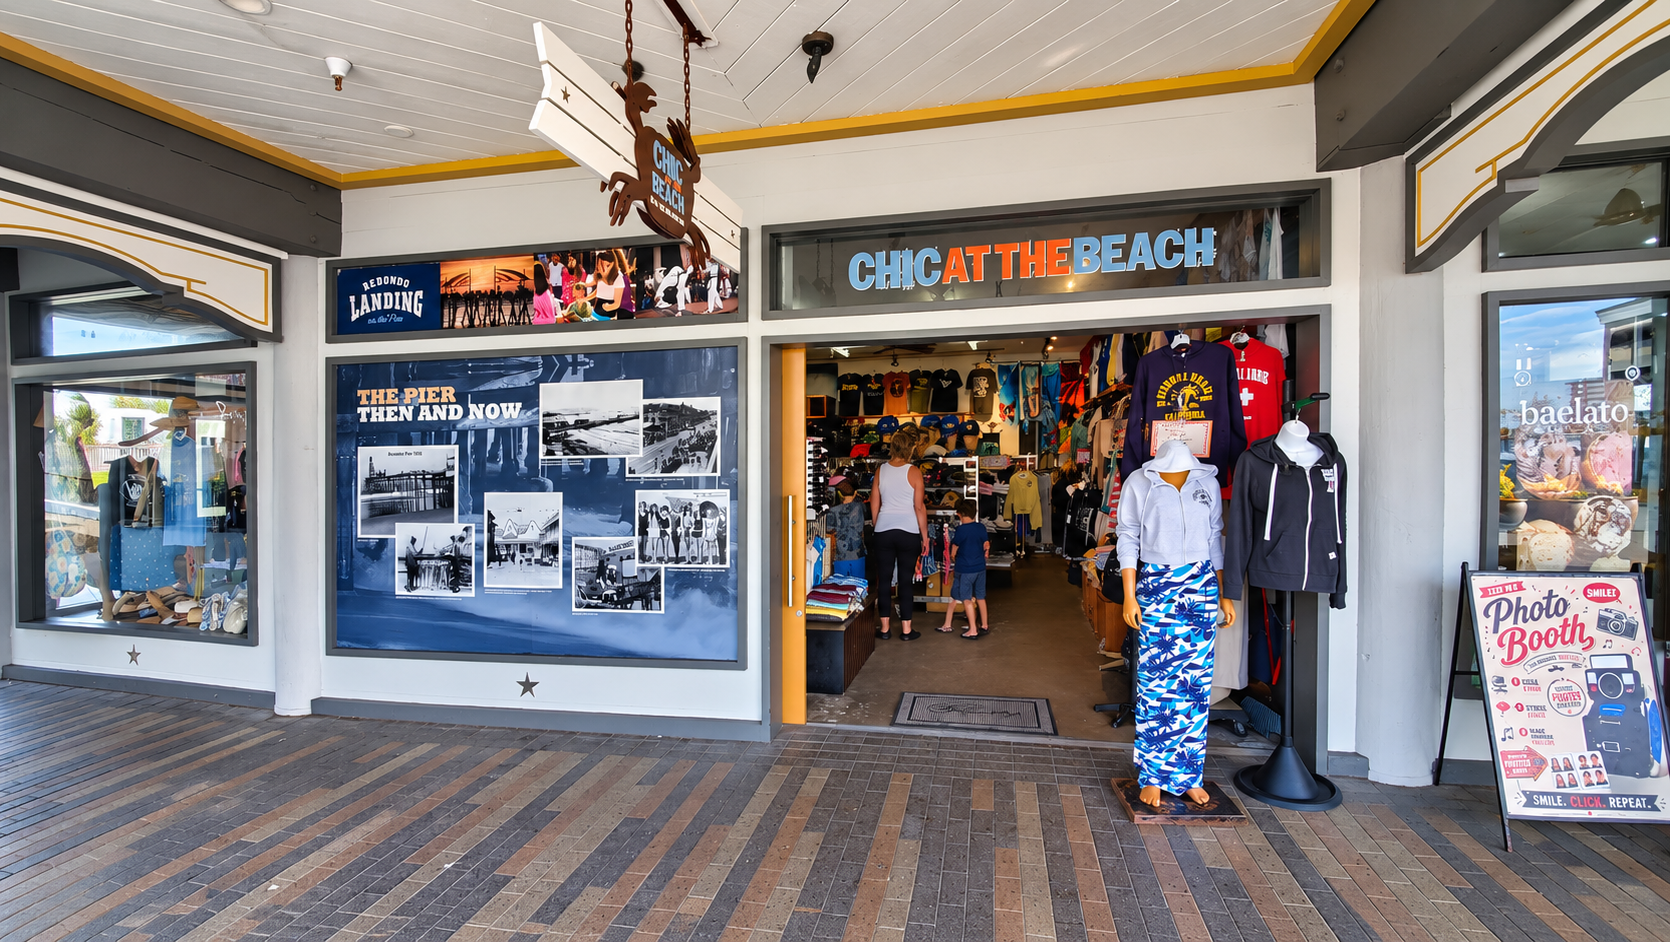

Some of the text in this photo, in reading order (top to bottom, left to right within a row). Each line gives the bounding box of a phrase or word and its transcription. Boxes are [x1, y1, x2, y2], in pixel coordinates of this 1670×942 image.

[652, 139, 684, 186] CHIC
[652, 170, 685, 216] BEACH
[362, 276, 410, 291] REDONDO
[349, 289, 424, 323] LANDING
[356, 386, 457, 406] THE PIER
[1519, 396, 1629, 426] baelato
[356, 402, 523, 423] THEN AND NOW
[1483, 589, 1570, 634] Photo
[1497, 613, 1595, 667] Booth
[1532, 794, 1652, 809] SMILE. CLICK. REPEAT.
